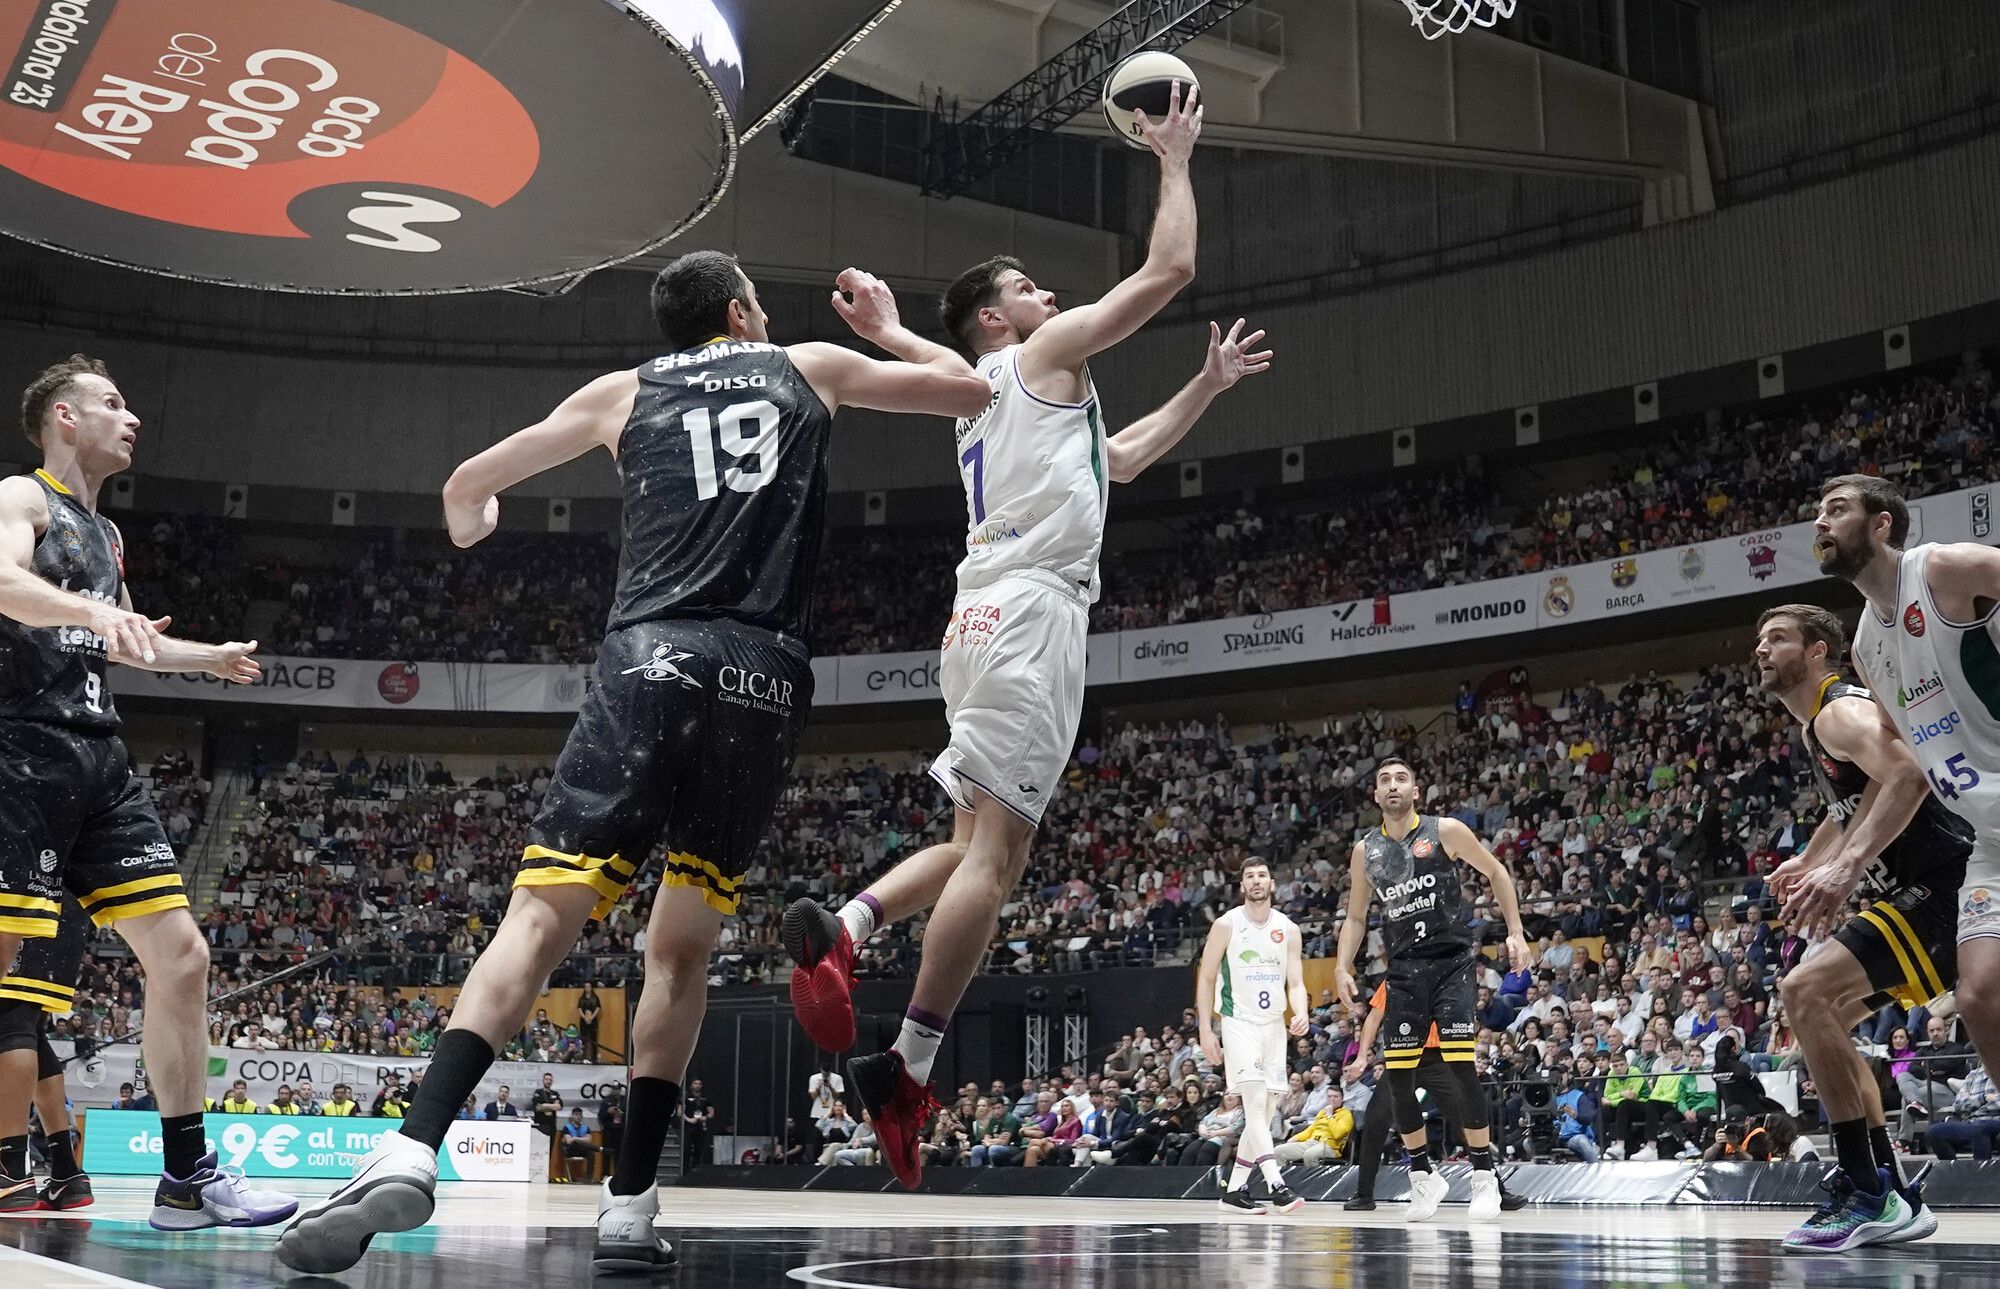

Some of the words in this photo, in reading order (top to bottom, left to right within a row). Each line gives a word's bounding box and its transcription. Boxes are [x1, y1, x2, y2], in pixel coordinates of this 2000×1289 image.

[153, 32, 222, 87] del
[55, 73, 191, 160] Rey
[185, 48, 339, 170] Copa
[297, 96, 380, 158] acb
[682, 400, 780, 501] 19
[1740, 531, 1782, 547] CAZOO
[1450, 599, 1527, 625] MONDO
[1606, 593, 1645, 610] BARÇA
[1134, 639, 1189, 660] divina
[1223, 624, 1304, 654] SPALDING
[85, 671, 103, 714] 9
[718, 665, 793, 706] CICAR
[718, 691, 752, 709] Canary
[753, 699, 780, 714] Islands
[1928, 751, 1981, 801] 45
[1376, 874, 1436, 902] Lenovo
[1258, 991, 1271, 1009] 8
[239, 1059, 313, 1083] COPA
[321, 1063, 367, 1085] DEL
[308, 1127, 335, 1149] al
[457, 1137, 514, 1155] divina
[308, 1153, 333, 1166] con
